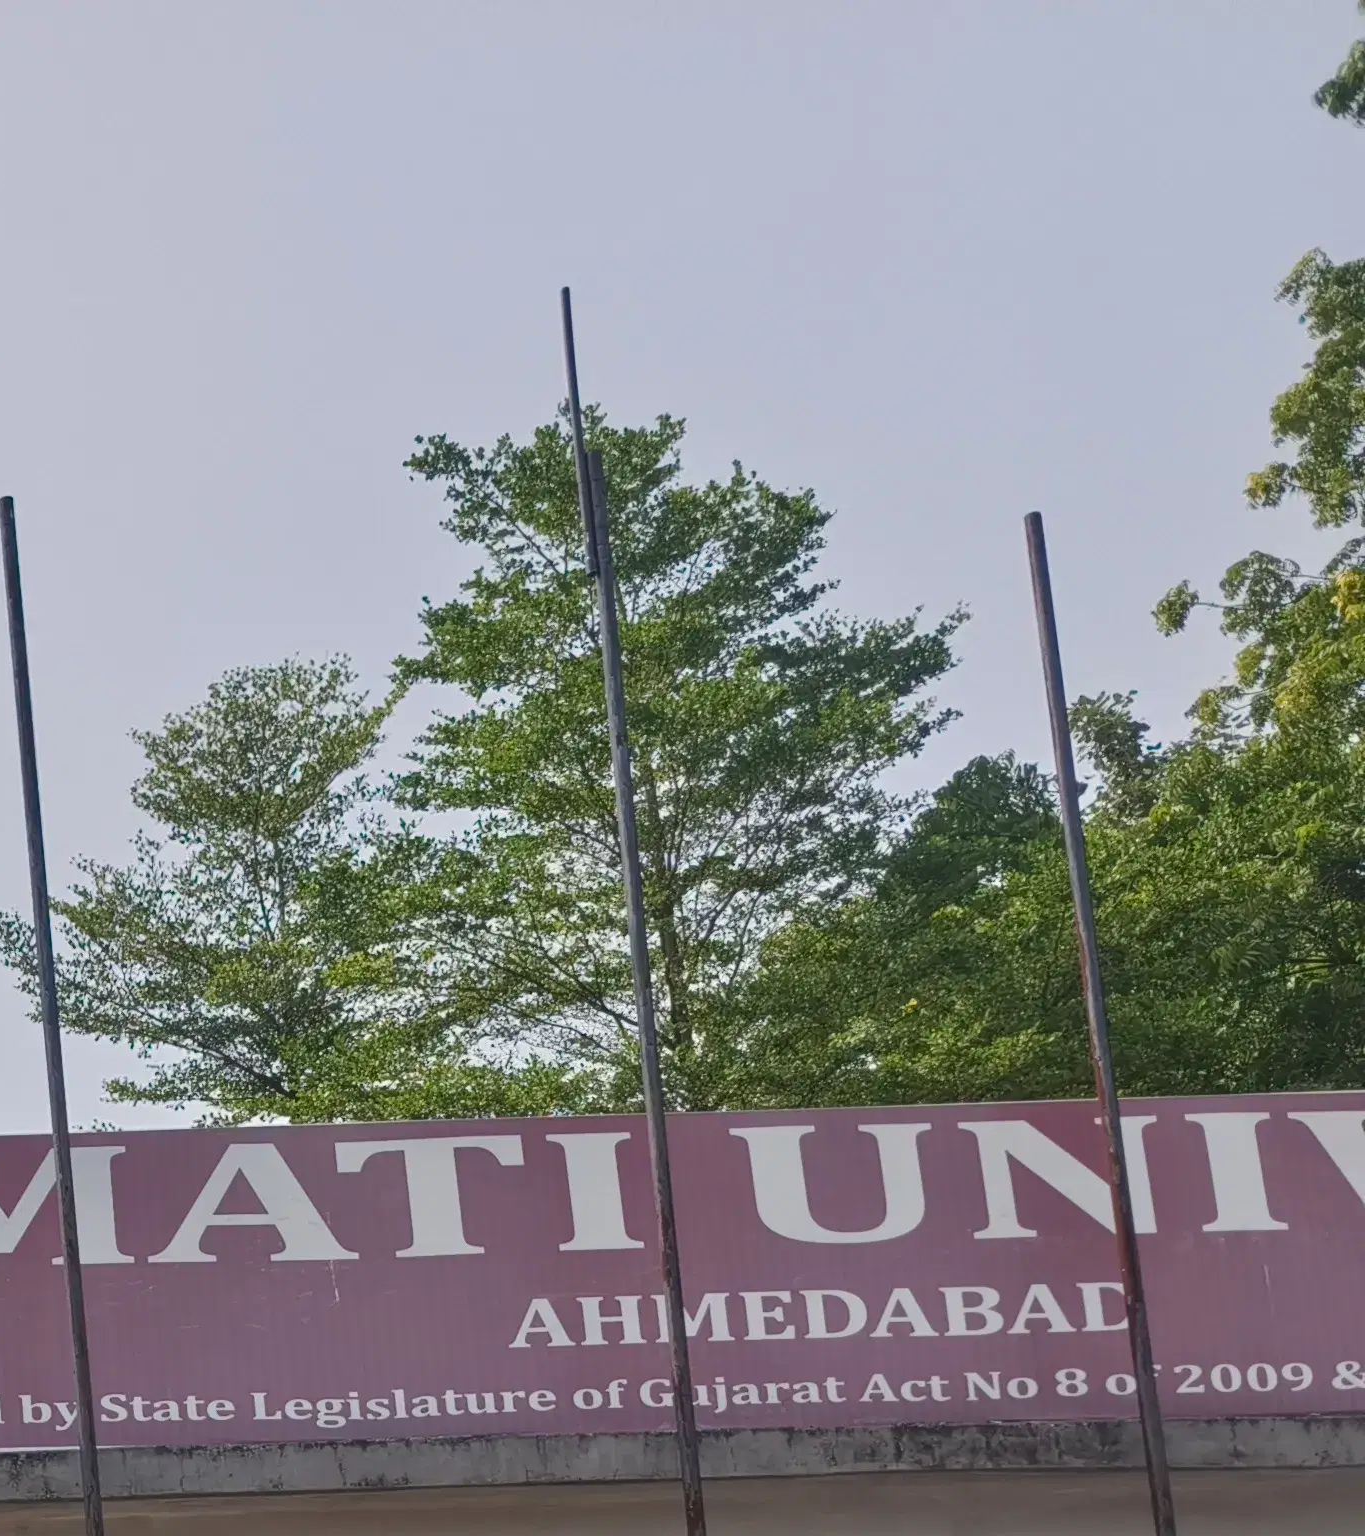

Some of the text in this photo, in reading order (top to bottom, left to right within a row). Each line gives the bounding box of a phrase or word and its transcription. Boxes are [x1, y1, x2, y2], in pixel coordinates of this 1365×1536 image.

[509, 1281, 1130, 1349] AHMEDABAD
[21, 1394, 78, 1433] by
[100, 1393, 235, 1424] State
[252, 1386, 556, 1430] Legislature
[573, 1378, 629, 1411] of
[639, 1375, 848, 1416] Gujarat
[859, 1371, 952, 1403] Act
[963, 1371, 1039, 1401] No
[1054, 1367, 1089, 1398] 8
[1106, 1364, 1162, 1396] o
[1173, 1361, 1313, 1394] 2009
[1331, 1360, 1365, 1391] &
